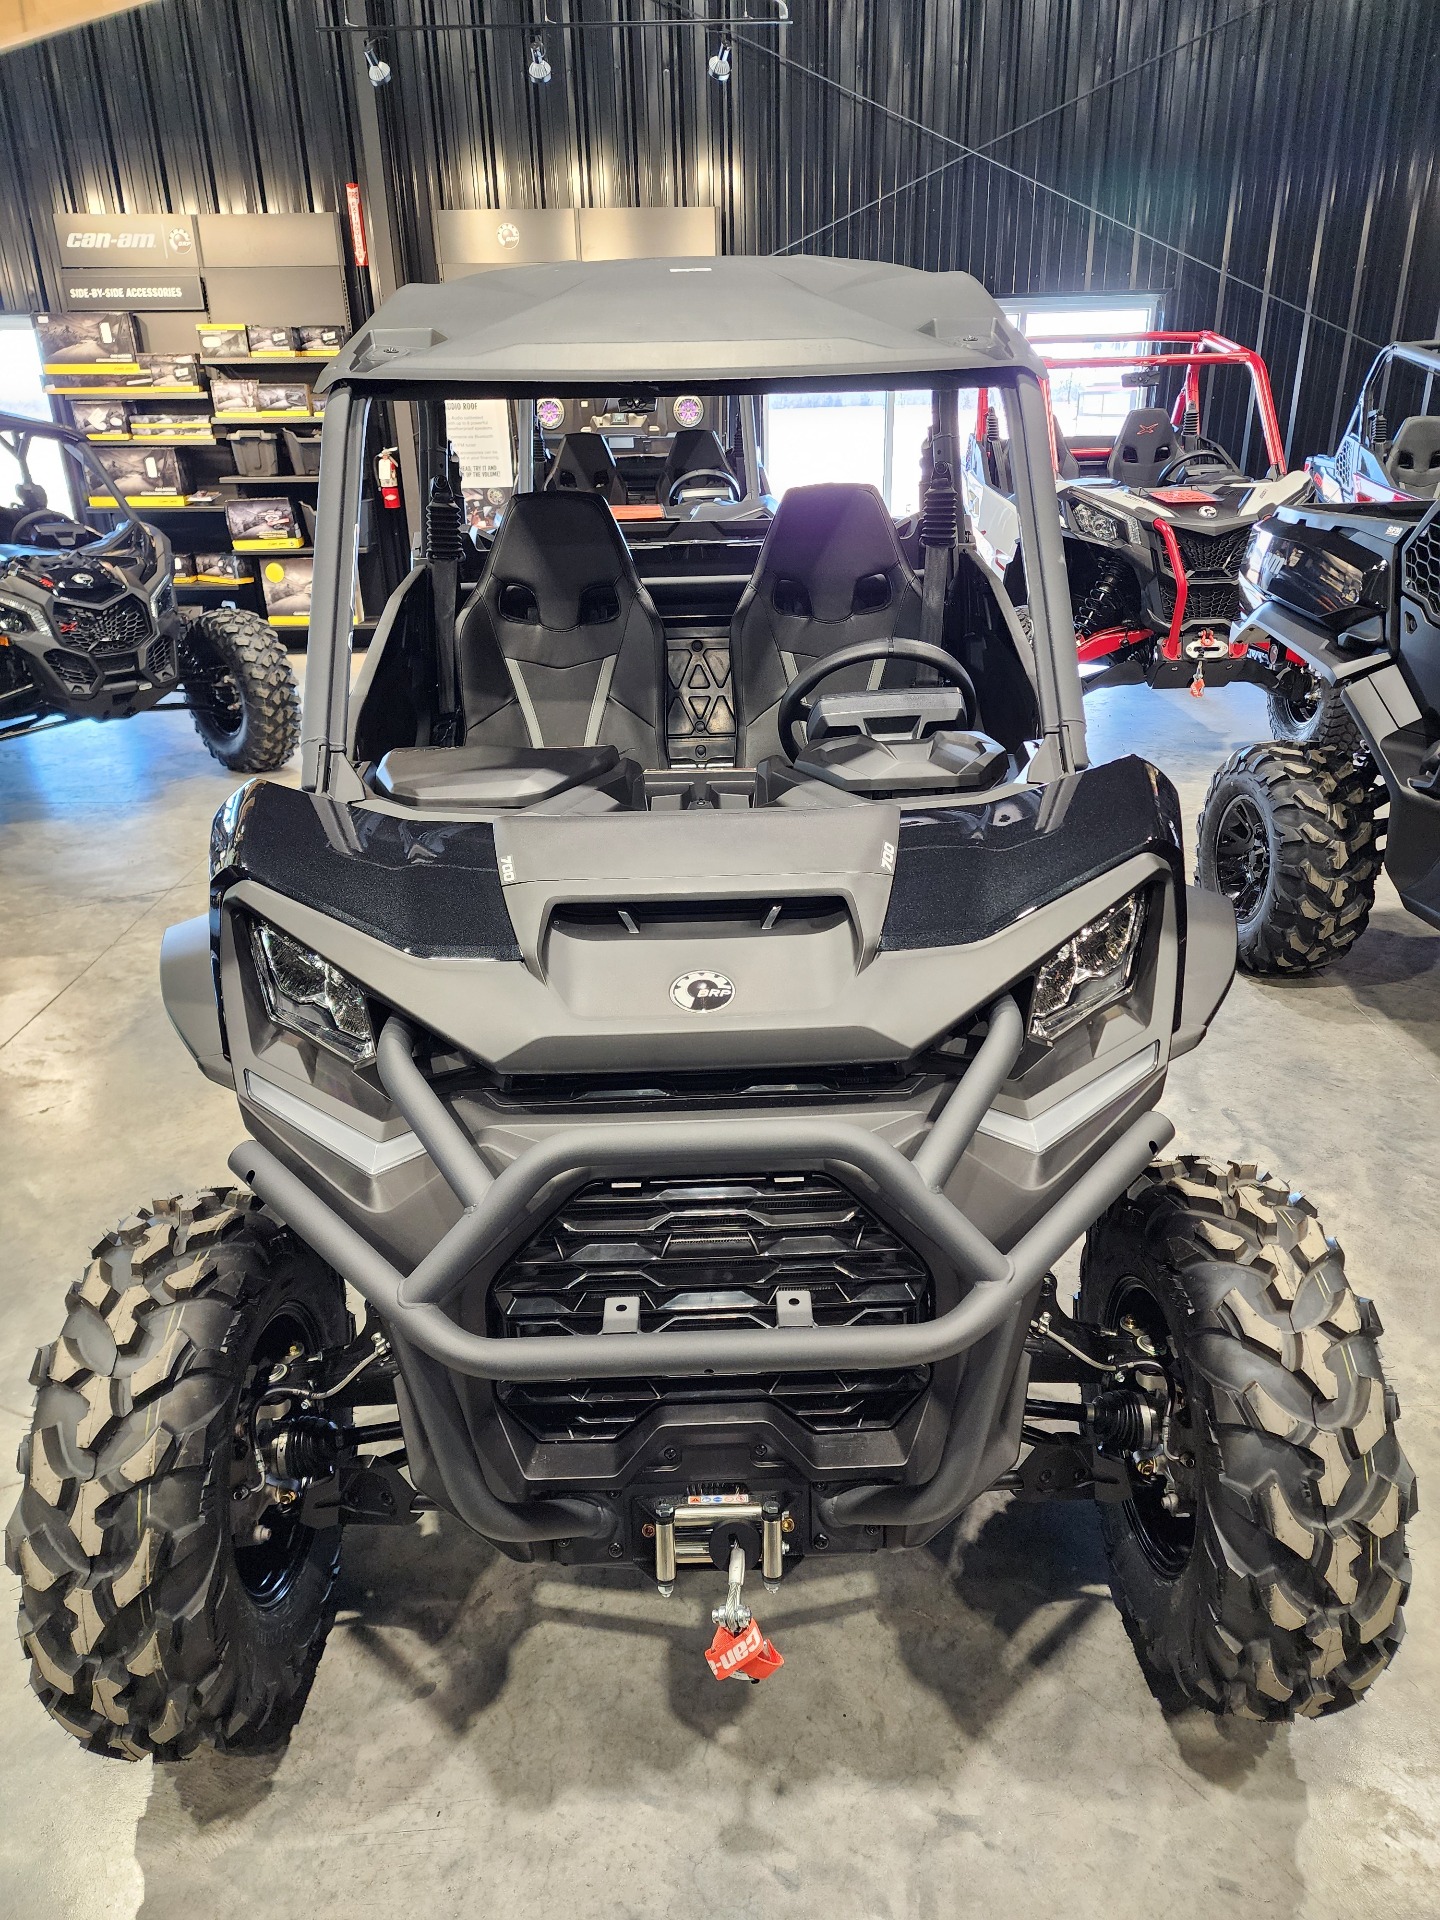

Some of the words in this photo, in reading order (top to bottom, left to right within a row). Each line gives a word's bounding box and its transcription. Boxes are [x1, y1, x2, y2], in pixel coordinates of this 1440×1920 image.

[66, 232, 156, 248] can-am
[69, 288, 124, 299] SIDE-BY-SIDE
[126, 287, 182, 298] ACCESSORIES
[463, 402, 478, 411] ROOF
[881, 841, 895, 872] 700
[500, 855, 515, 882] 700
[697, 988, 732, 998] BRP
